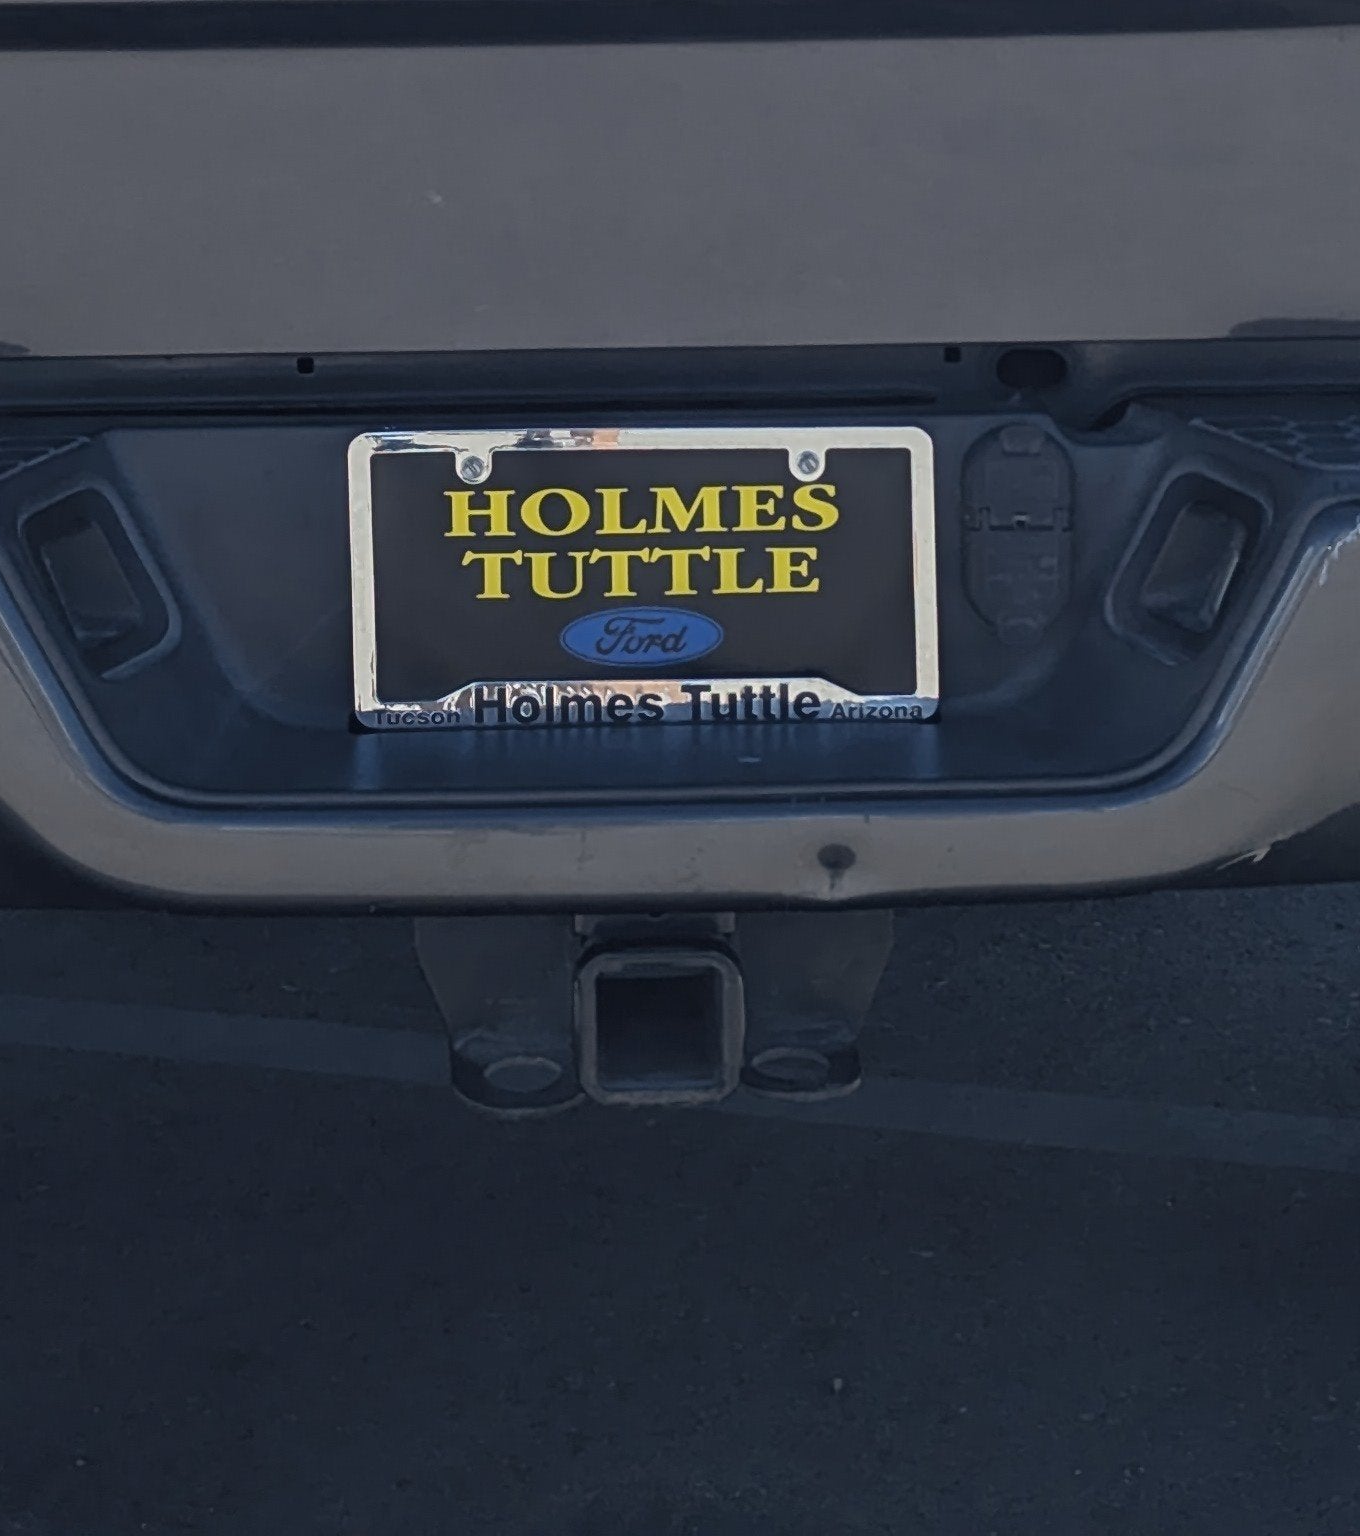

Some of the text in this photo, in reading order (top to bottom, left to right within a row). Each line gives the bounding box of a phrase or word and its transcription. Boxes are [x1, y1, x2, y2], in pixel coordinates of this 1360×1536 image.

[443, 483, 840, 538] HOLMES
[461, 545, 820, 600] TUTTLE
[596, 616, 688, 655] Ford
[375, 682, 924, 726] Tucson Holmes Tuttle Arizona
